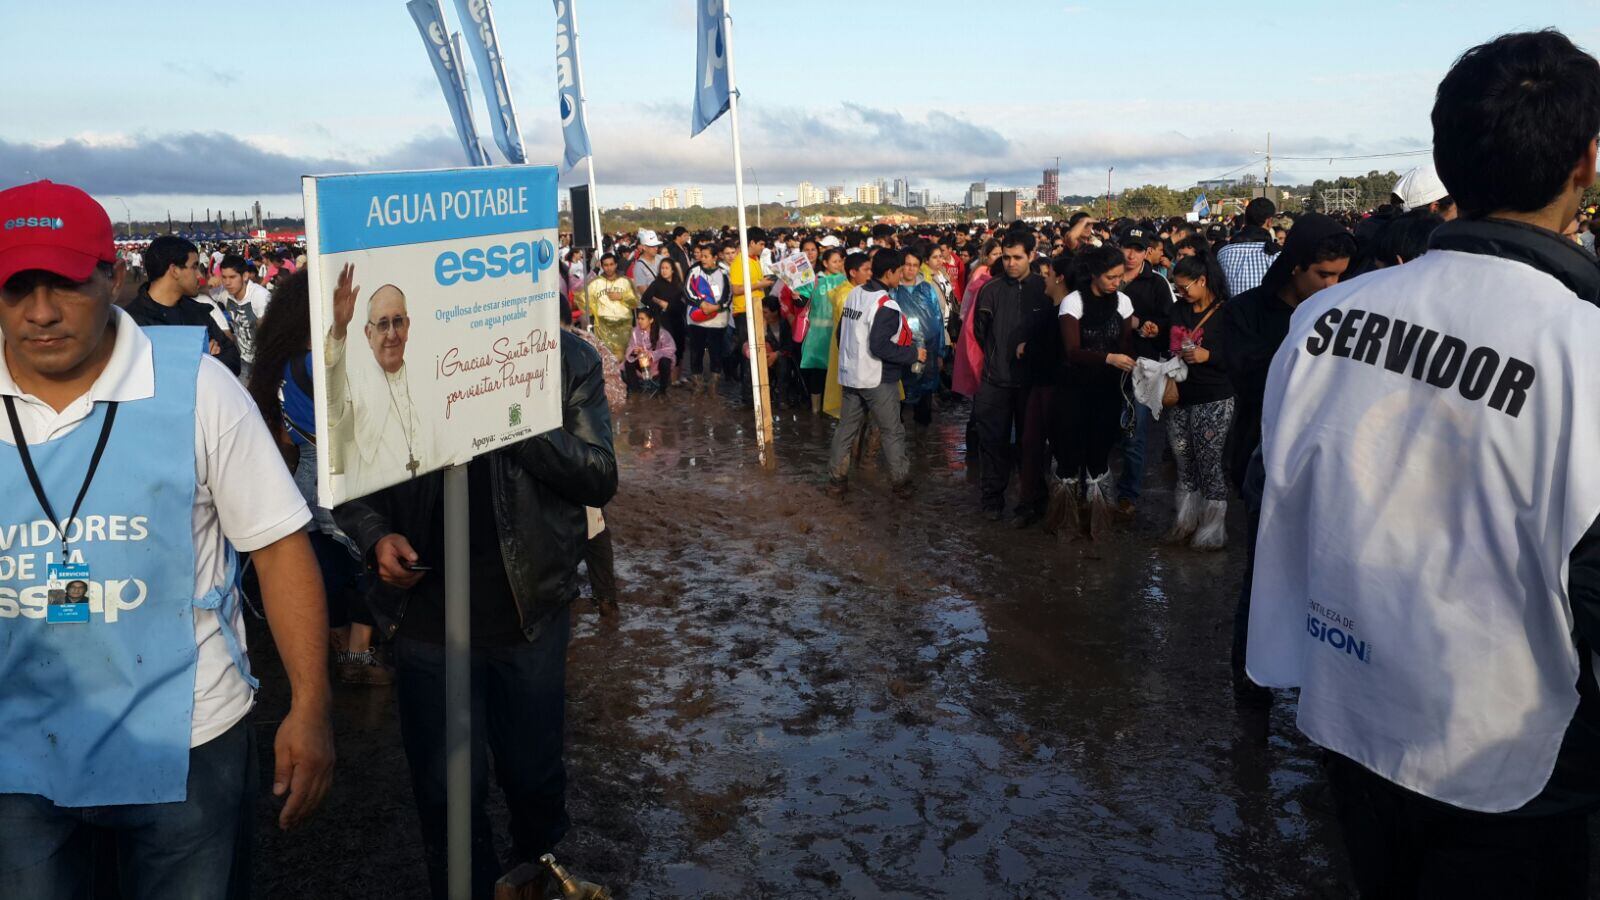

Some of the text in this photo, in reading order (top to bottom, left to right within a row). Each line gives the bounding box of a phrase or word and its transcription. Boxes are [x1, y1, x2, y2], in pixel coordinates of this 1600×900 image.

[5, 217, 64, 230] essap
[366, 187, 528, 227] AGUA POTABLE
[1130, 229, 1143, 238] CAT
[434, 237, 554, 286] essap
[435, 290, 556, 323] Orgullosa de estar siempre presente
[470, 308, 527, 329] con agua potable
[436, 328, 557, 380] ¡Gracias Santo Padre
[1306, 308, 1536, 418] SERVIDOR
[445, 354, 549, 419] por visitar Paraguay!
[471, 434, 495, 450] Apoya:
[1343, 617, 1355, 630] DE
